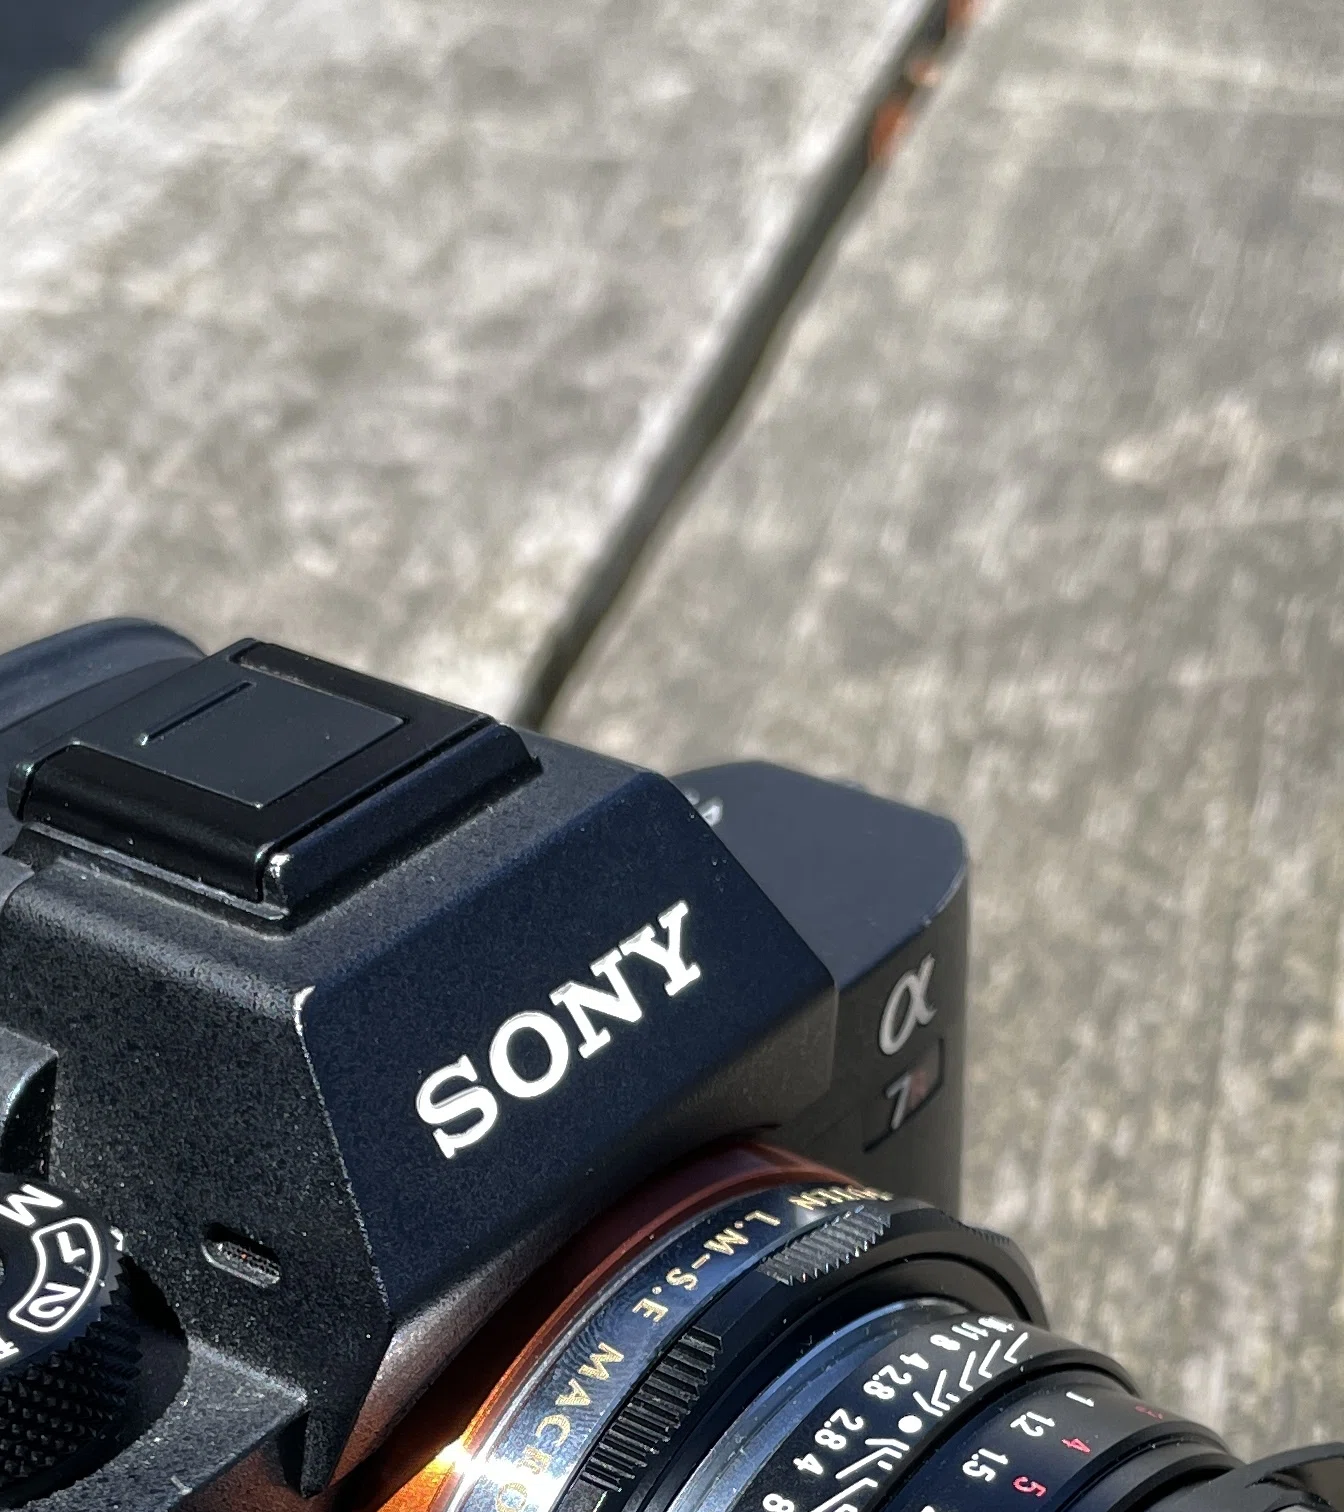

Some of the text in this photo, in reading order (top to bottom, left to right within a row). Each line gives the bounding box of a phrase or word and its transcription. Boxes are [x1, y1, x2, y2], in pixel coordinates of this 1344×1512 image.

[415, 900, 702, 1160] SONY
[56, 1231, 86, 1263] 1
[28, 1282, 81, 1319] 2
[929, 1334, 961, 1351] 8
[899, 1352, 930, 1370] 4
[863, 1364, 912, 1400] 2.8
[814, 1408, 864, 1451] 2.8
[1061, 1438, 1091, 1453] 4
[793, 1453, 824, 1475] 4
[962, 1448, 1009, 1482] 1.5
[1013, 1476, 1047, 1497] 5
